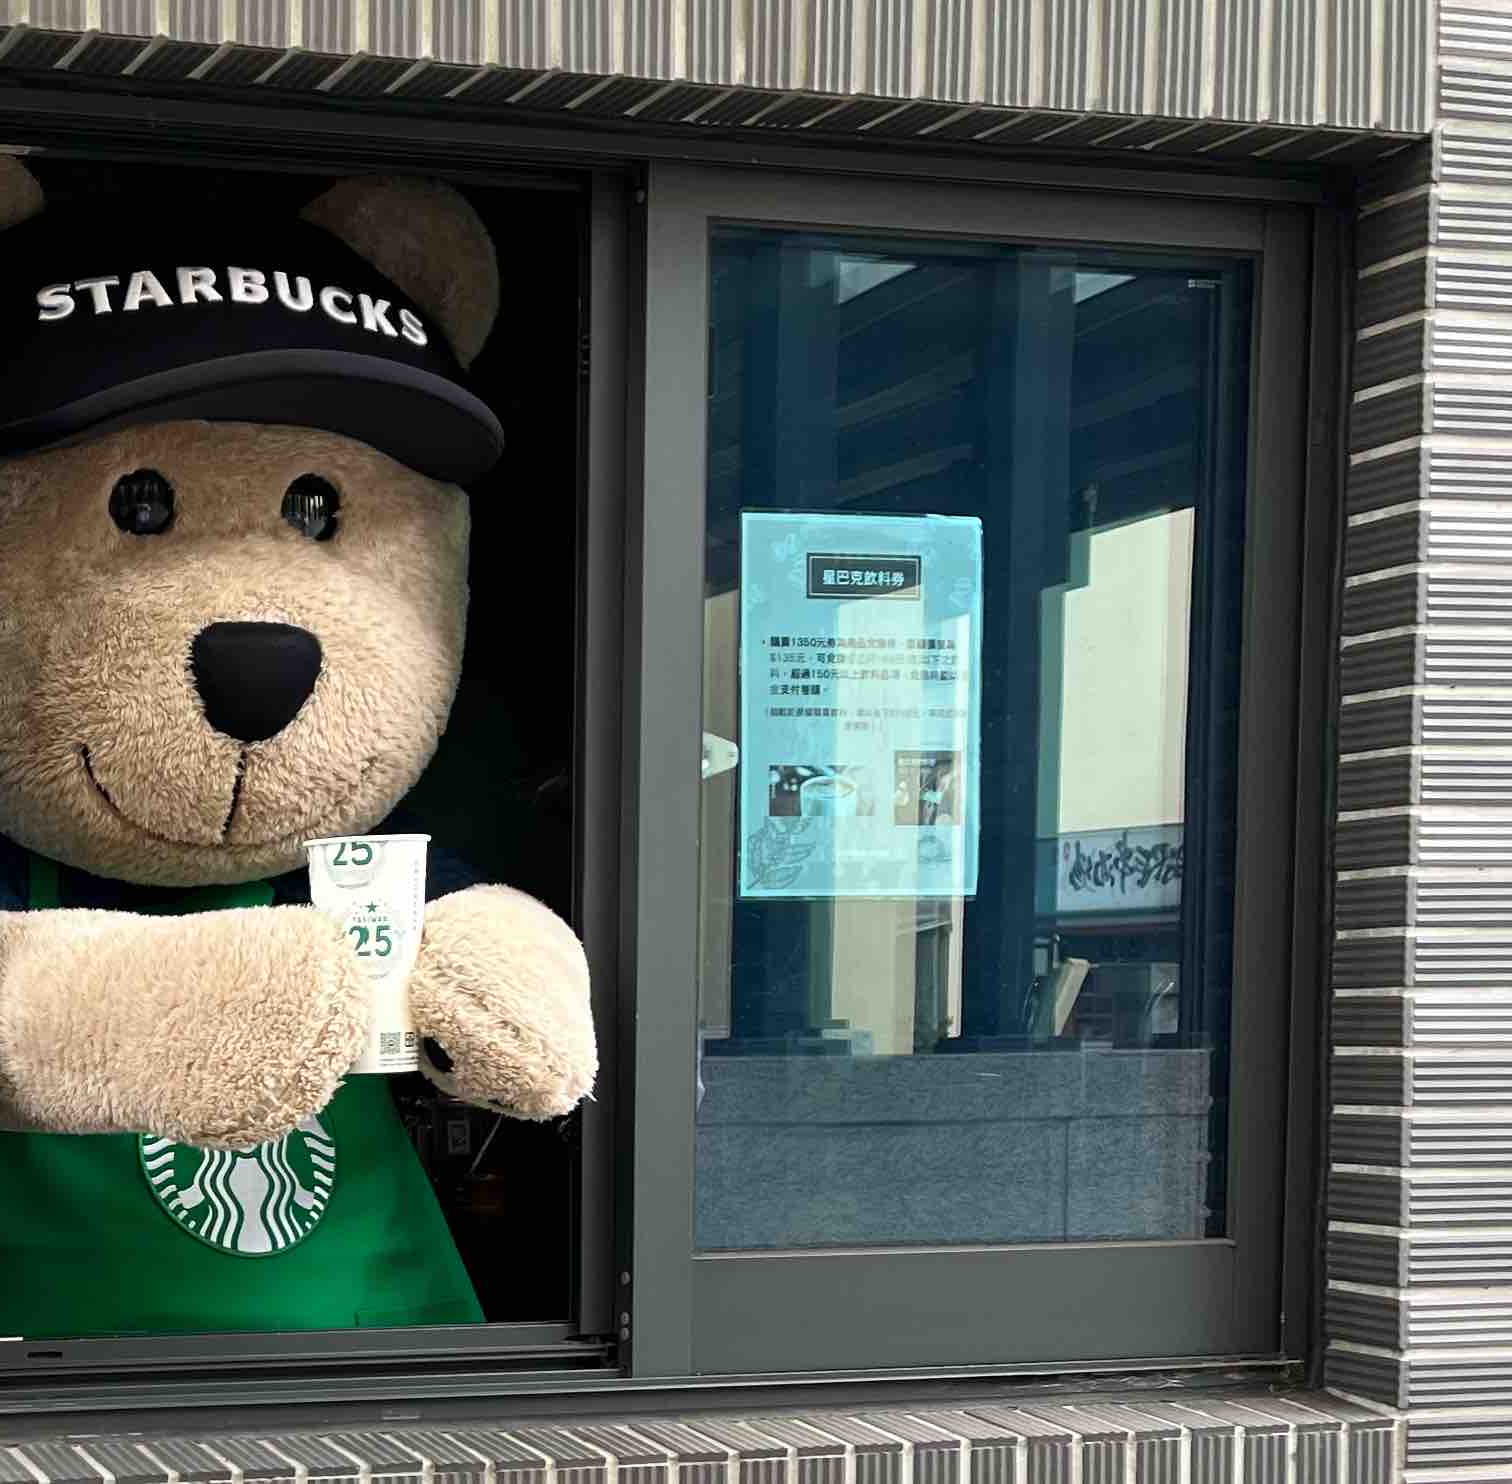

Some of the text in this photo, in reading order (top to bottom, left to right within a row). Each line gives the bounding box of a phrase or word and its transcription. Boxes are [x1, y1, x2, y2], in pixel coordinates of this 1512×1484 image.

[37, 266, 428, 346] STARBUCKS
[822, 569, 905, 587] 星巴克飲料券
[349, 925, 392, 957] 25
